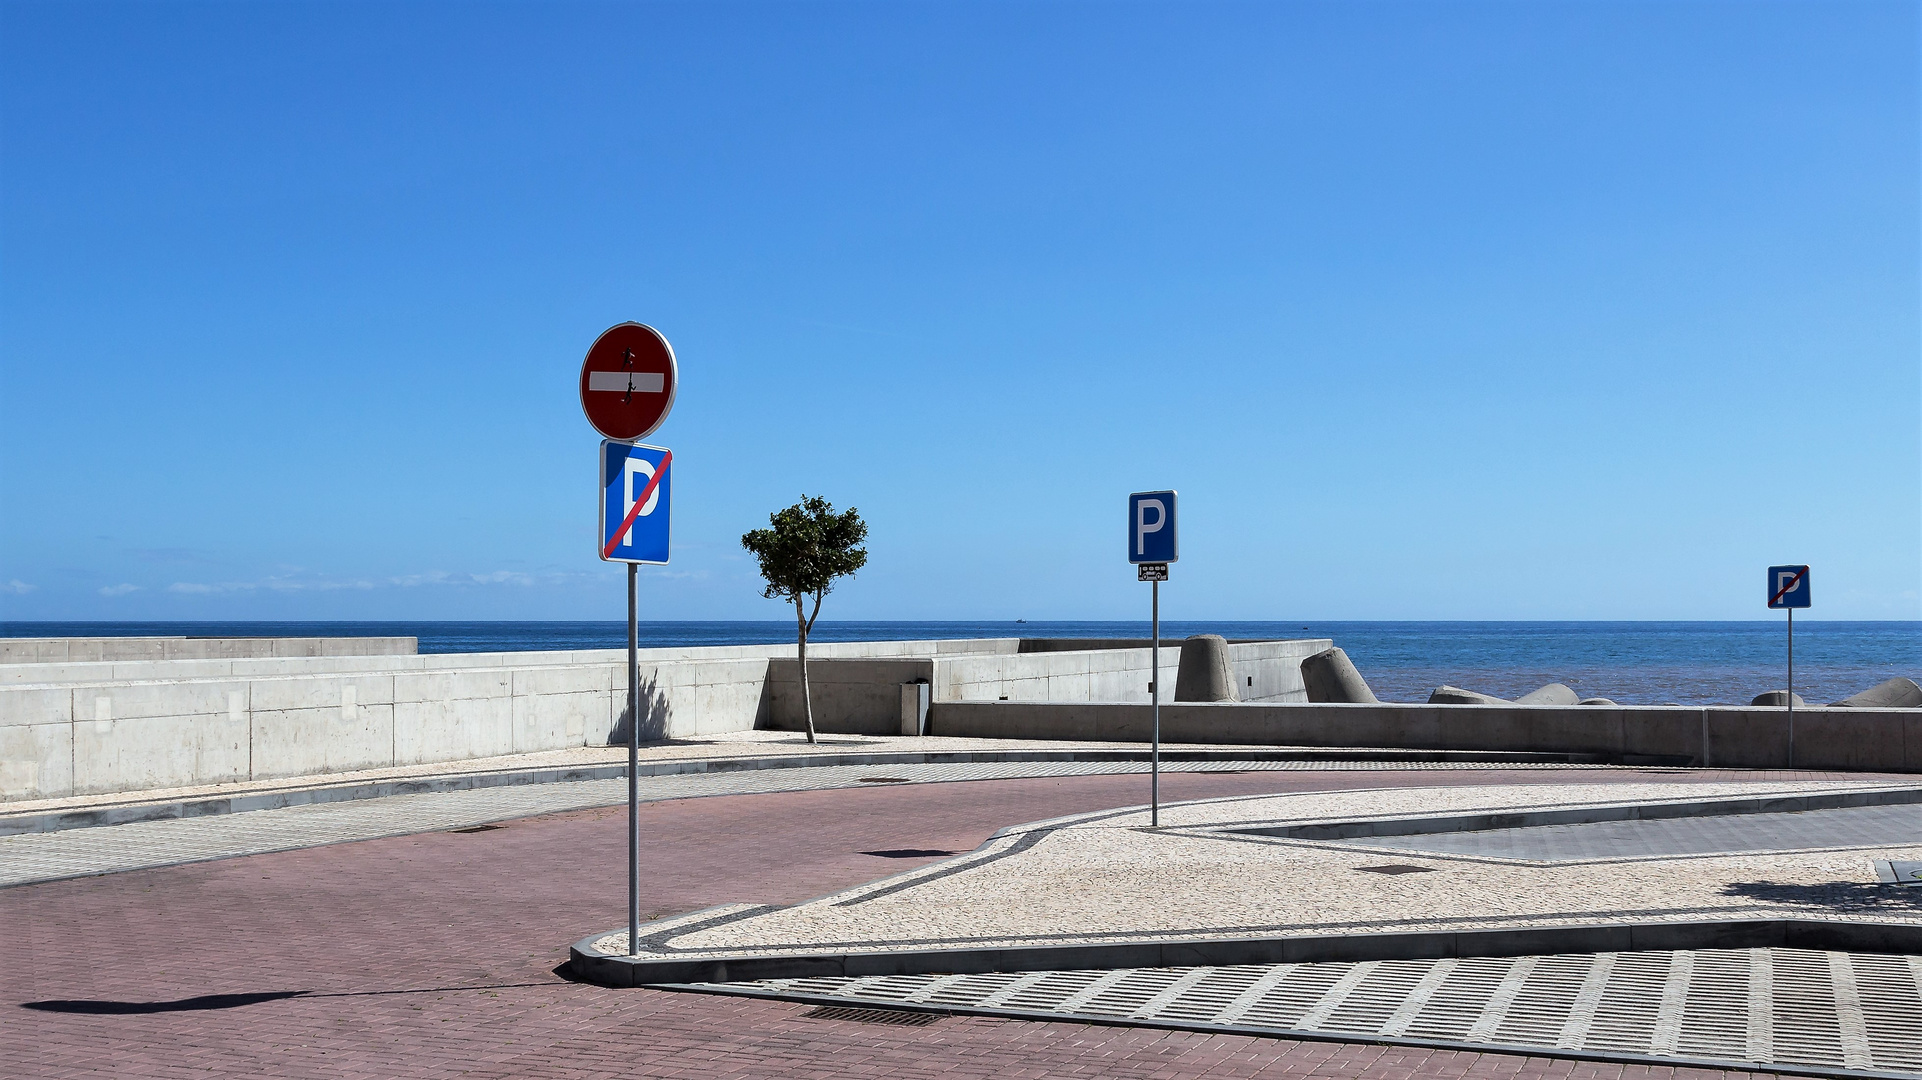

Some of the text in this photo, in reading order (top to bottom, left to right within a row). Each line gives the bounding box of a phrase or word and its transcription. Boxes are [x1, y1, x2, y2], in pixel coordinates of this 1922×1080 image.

[623, 457, 660, 547] P
[1138, 499, 1166, 554] P
[1777, 572, 1800, 604] P
